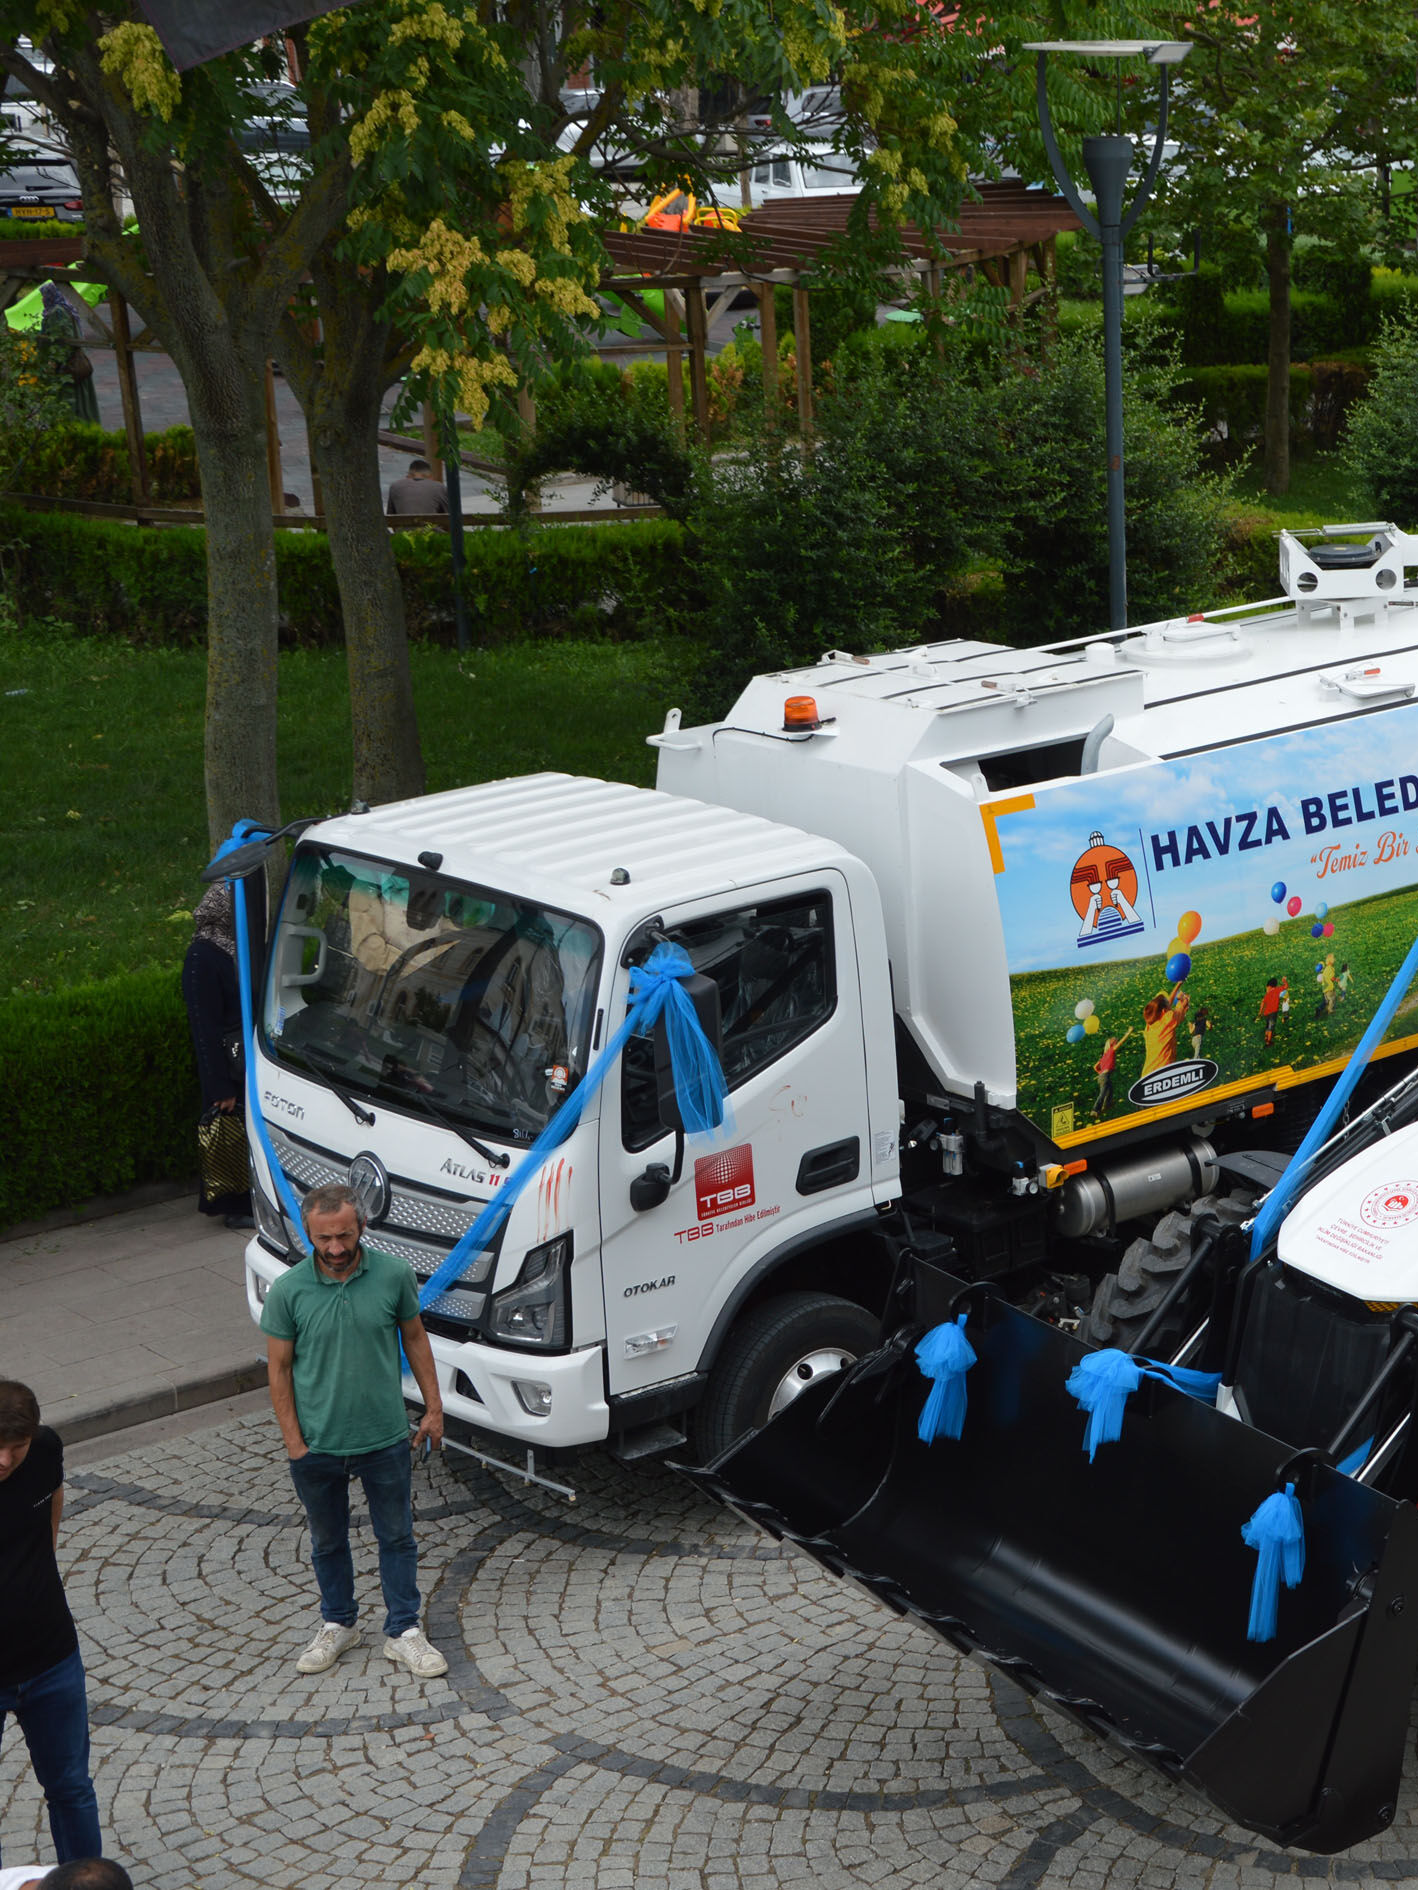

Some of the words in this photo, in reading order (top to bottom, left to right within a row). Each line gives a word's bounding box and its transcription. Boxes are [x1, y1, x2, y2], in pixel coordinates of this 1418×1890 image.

[1151, 806, 1291, 872] HAVZA
[1373, 830, 1409, 865] Bir
[700, 1183, 751, 1208] TBB
[674, 1222, 714, 1244] TBB
[624, 1275, 676, 1298] OTOKAR
